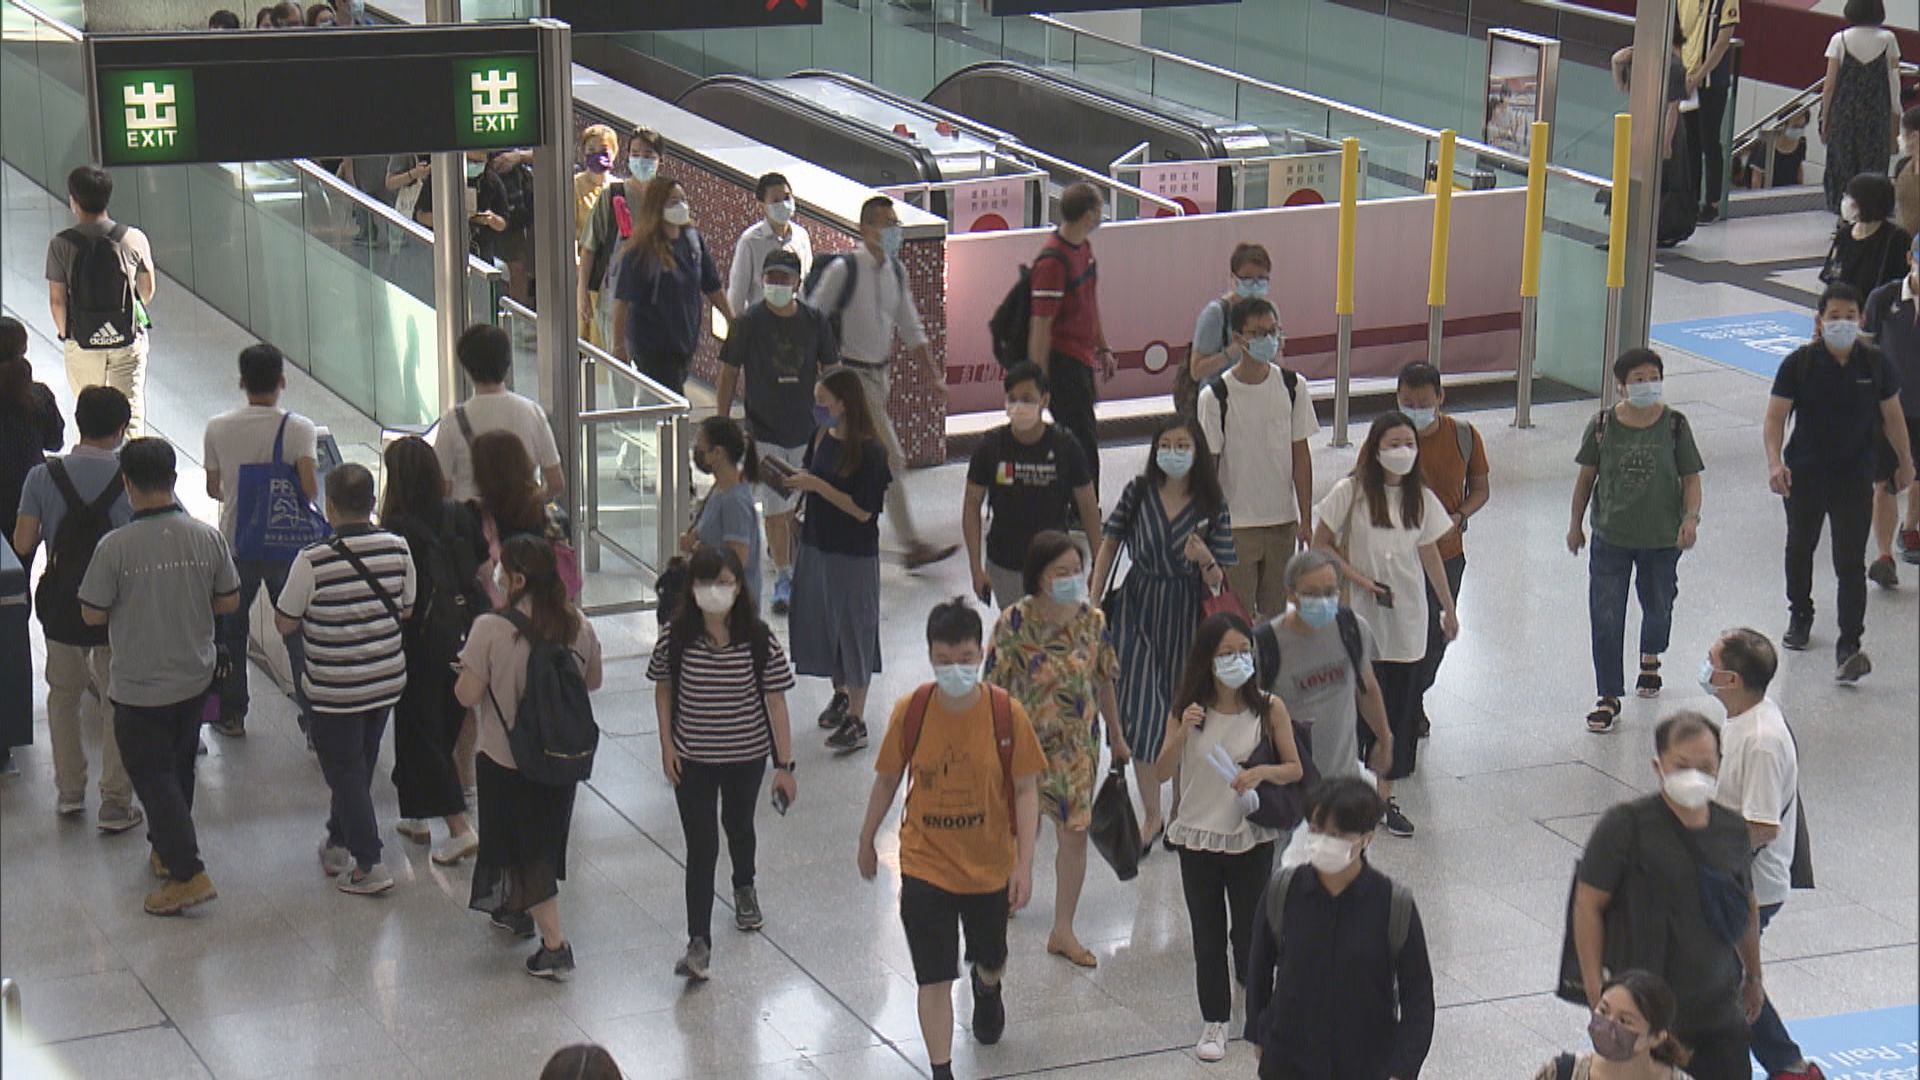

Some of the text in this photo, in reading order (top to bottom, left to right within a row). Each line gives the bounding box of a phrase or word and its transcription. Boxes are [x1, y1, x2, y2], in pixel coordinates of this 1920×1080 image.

[471, 70, 518, 114] 出
[124, 82, 177, 129] 出
[473, 115, 518, 133] EXIT
[127, 130, 178, 148] EXIT
[89, 335, 125, 346] adidas
[922, 812, 985, 829] SNOOPY
